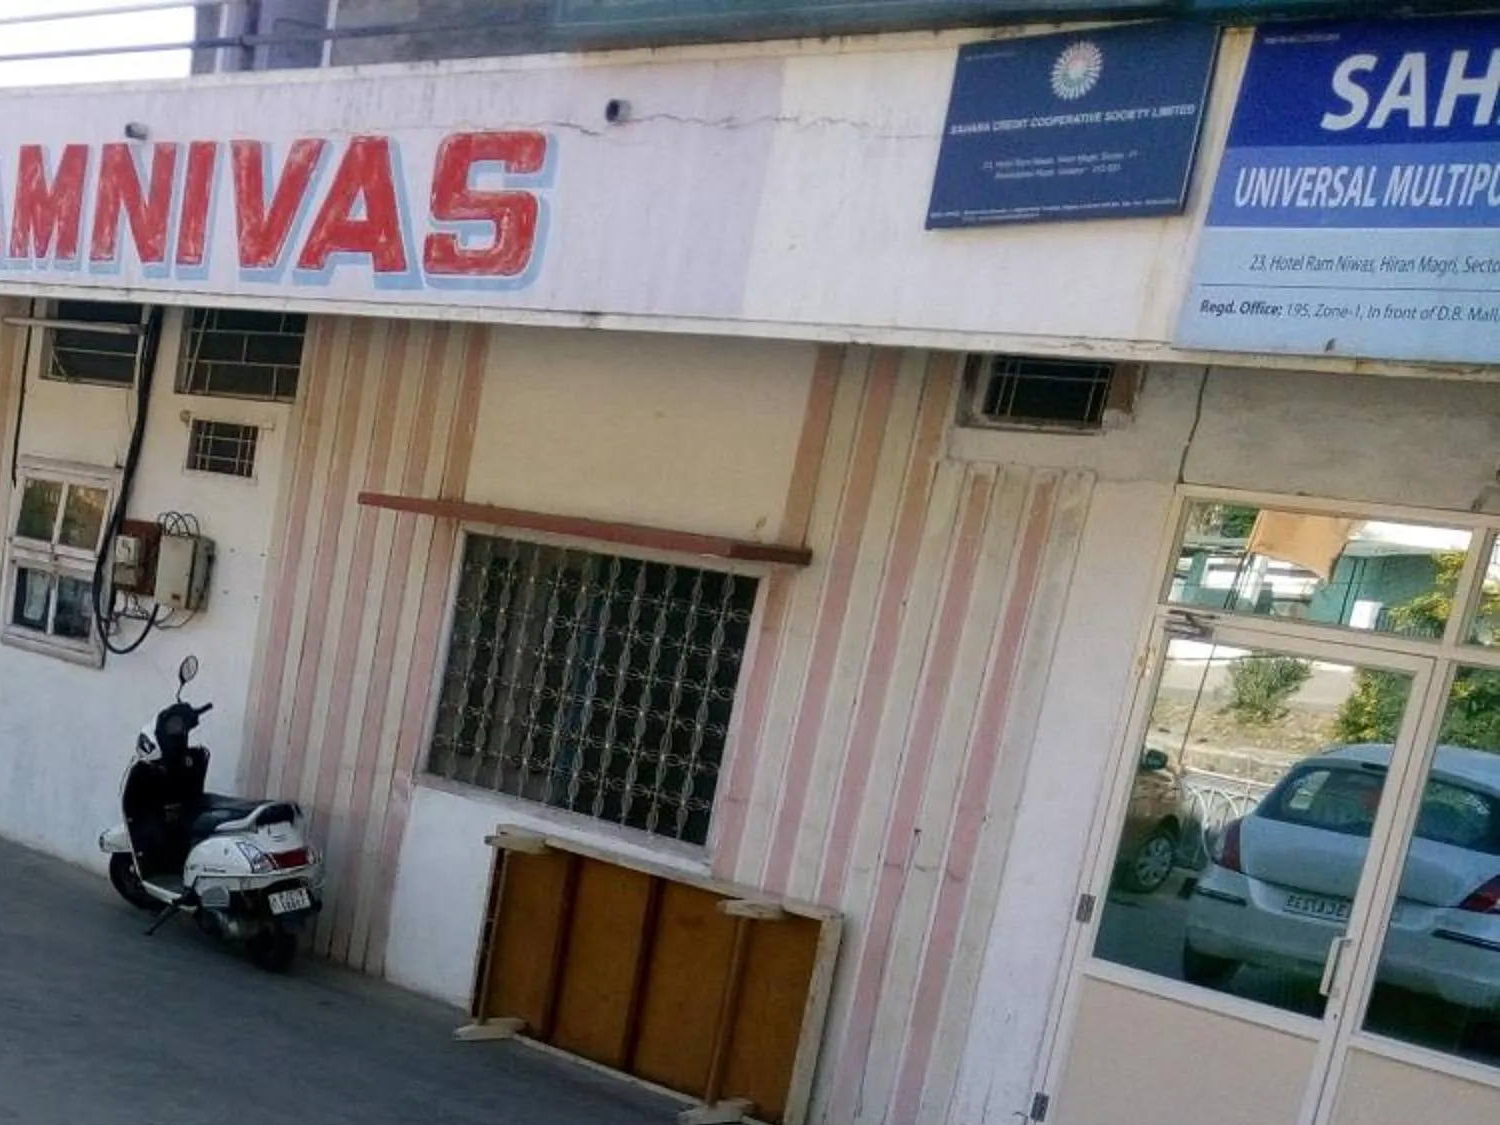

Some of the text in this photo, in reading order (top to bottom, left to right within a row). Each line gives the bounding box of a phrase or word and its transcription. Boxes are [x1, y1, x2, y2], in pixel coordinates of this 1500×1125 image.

[1320, 50, 1500, 131] SAH
[1104, 107, 1150, 122] SOCIETY
[1235, 165, 1377, 208] UNIVERSAL
[1269, 255, 1305, 272] Hotel
[1306, 256, 1334, 272] Ram
[1380, 256, 1415, 273] Hiran
[1200, 299, 1237, 317] Regd.
[1366, 304, 1382, 320] In
[1384, 303, 1418, 320] front
[1419, 303, 1440, 321] of
